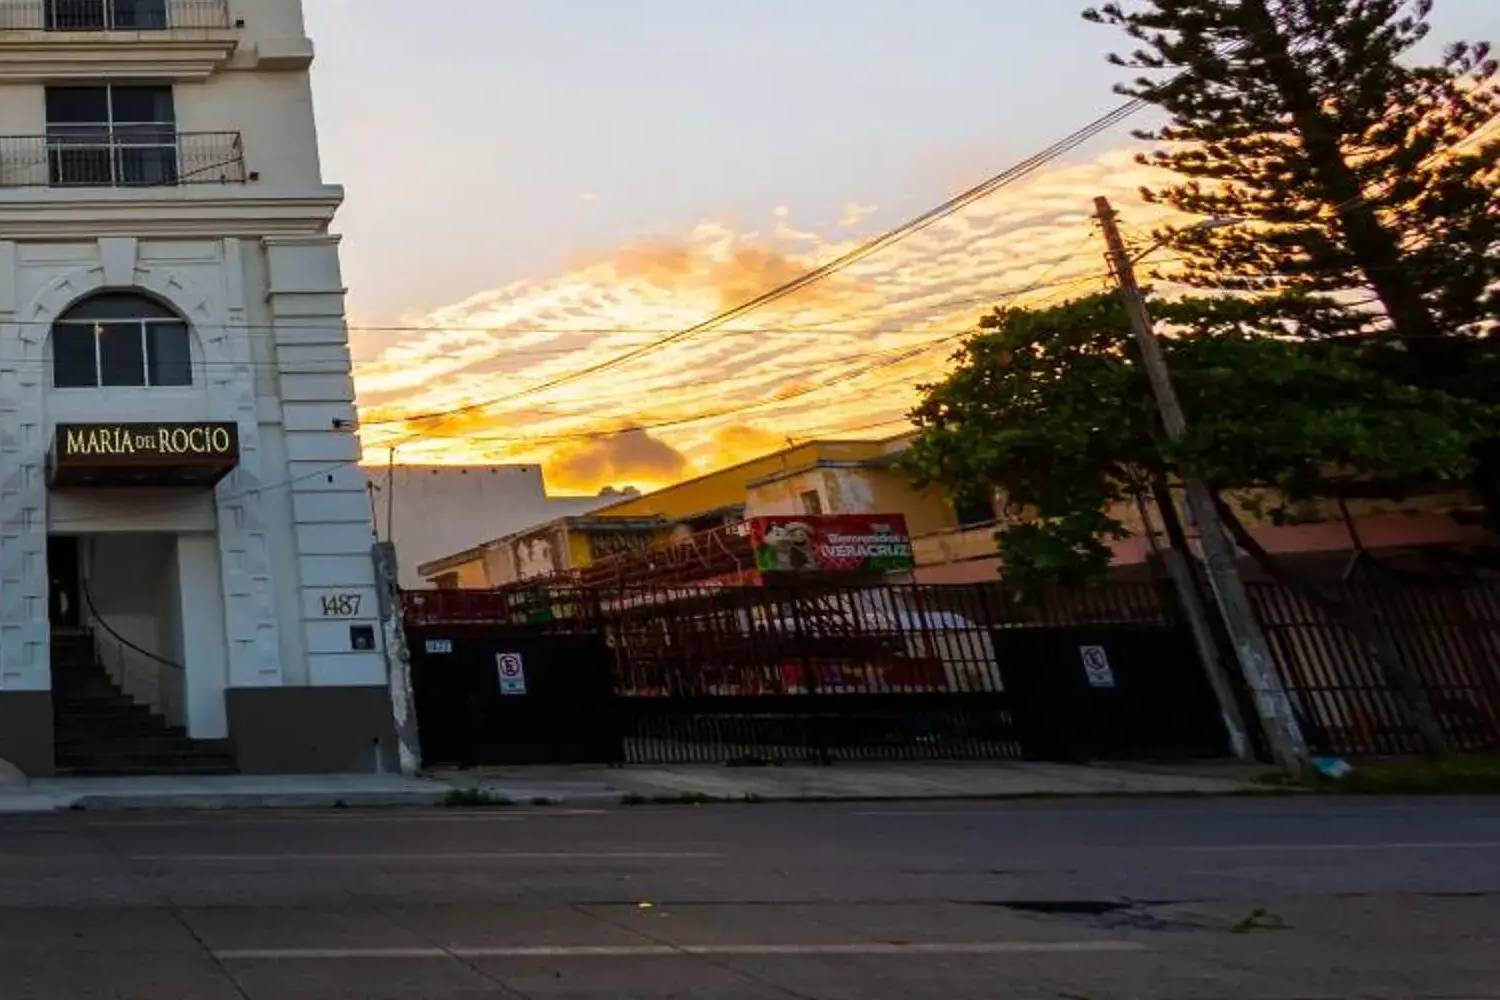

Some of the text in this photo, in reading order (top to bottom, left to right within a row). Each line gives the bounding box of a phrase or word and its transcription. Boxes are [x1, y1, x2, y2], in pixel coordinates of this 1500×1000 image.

[67, 426, 229, 453] MARÍA DEL ROCÍO
[321, 594, 361, 615] 1487
